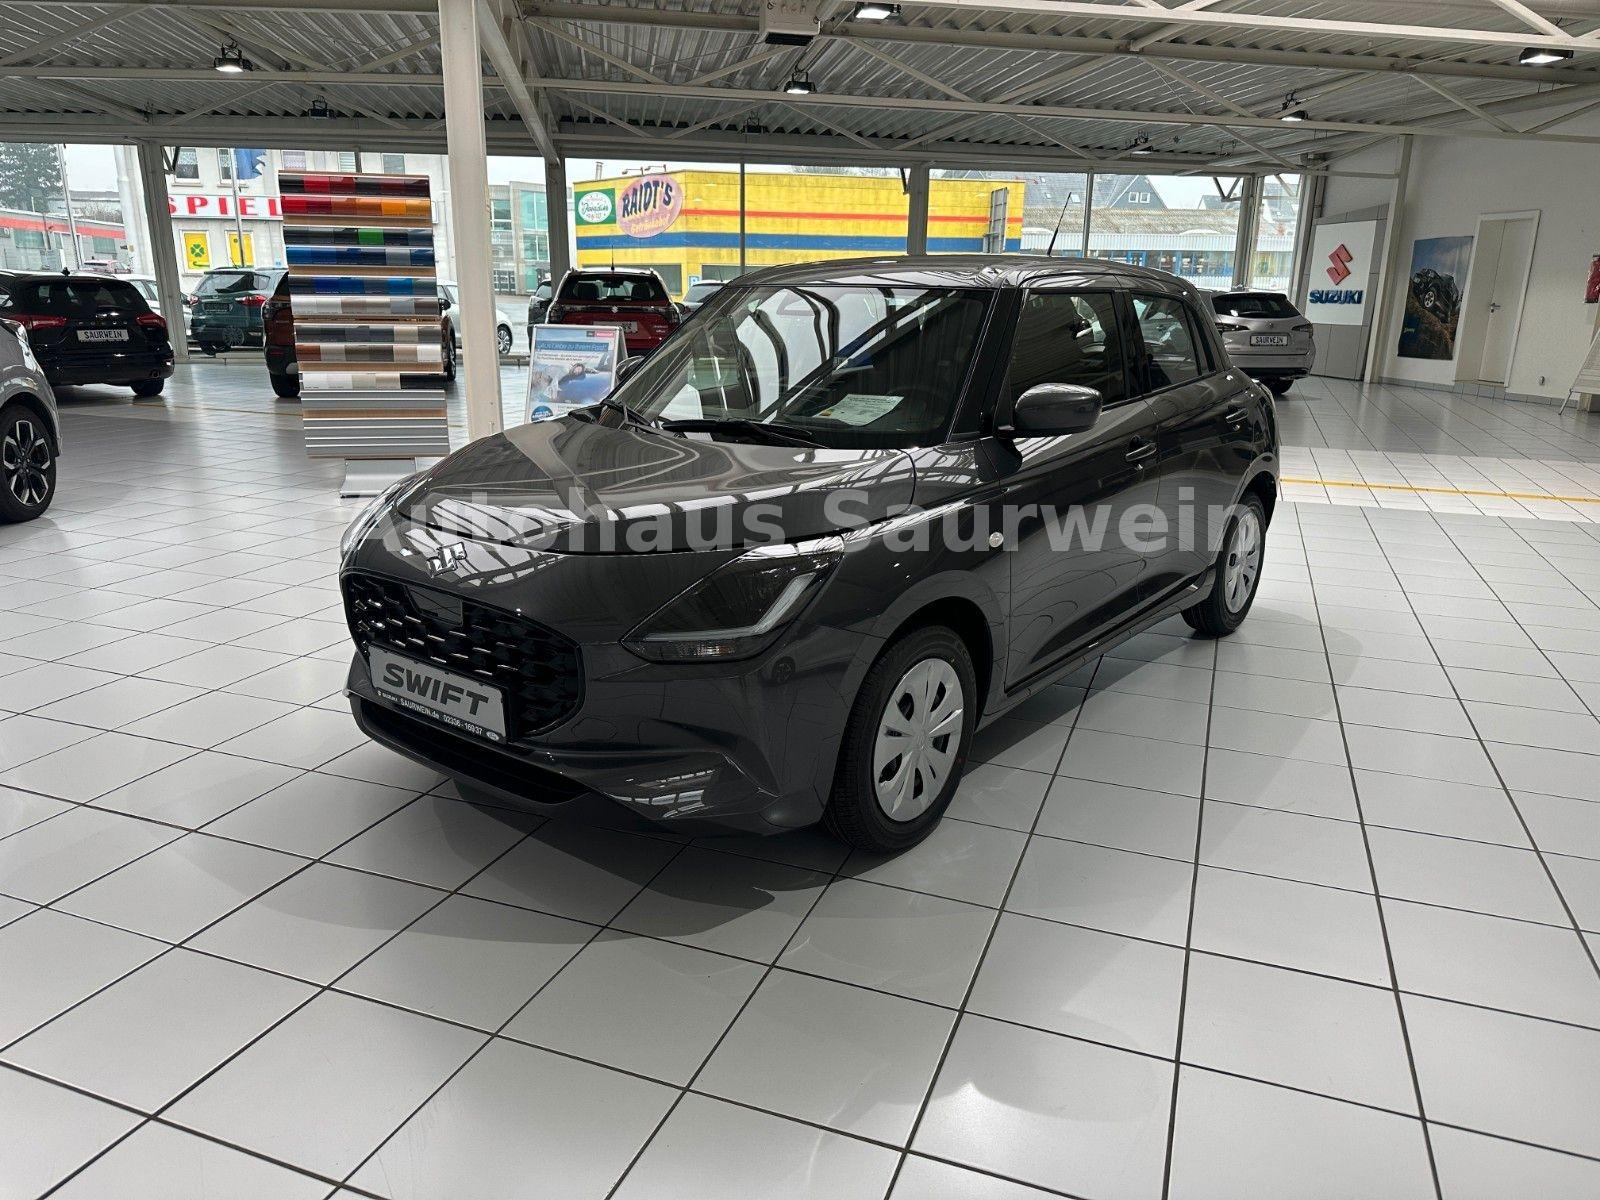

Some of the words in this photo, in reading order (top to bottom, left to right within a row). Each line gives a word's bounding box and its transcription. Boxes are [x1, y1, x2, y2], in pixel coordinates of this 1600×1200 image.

[622, 180, 673, 218] RAIDT'S
[1309, 289, 1364, 304] SUZUKI
[84, 330, 123, 339] SAURWEIN
[1255, 336, 1284, 344] SAURWEIN
[383, 662, 489, 716] SWIFT
[400, 698, 440, 720] SAURWEIN.de
